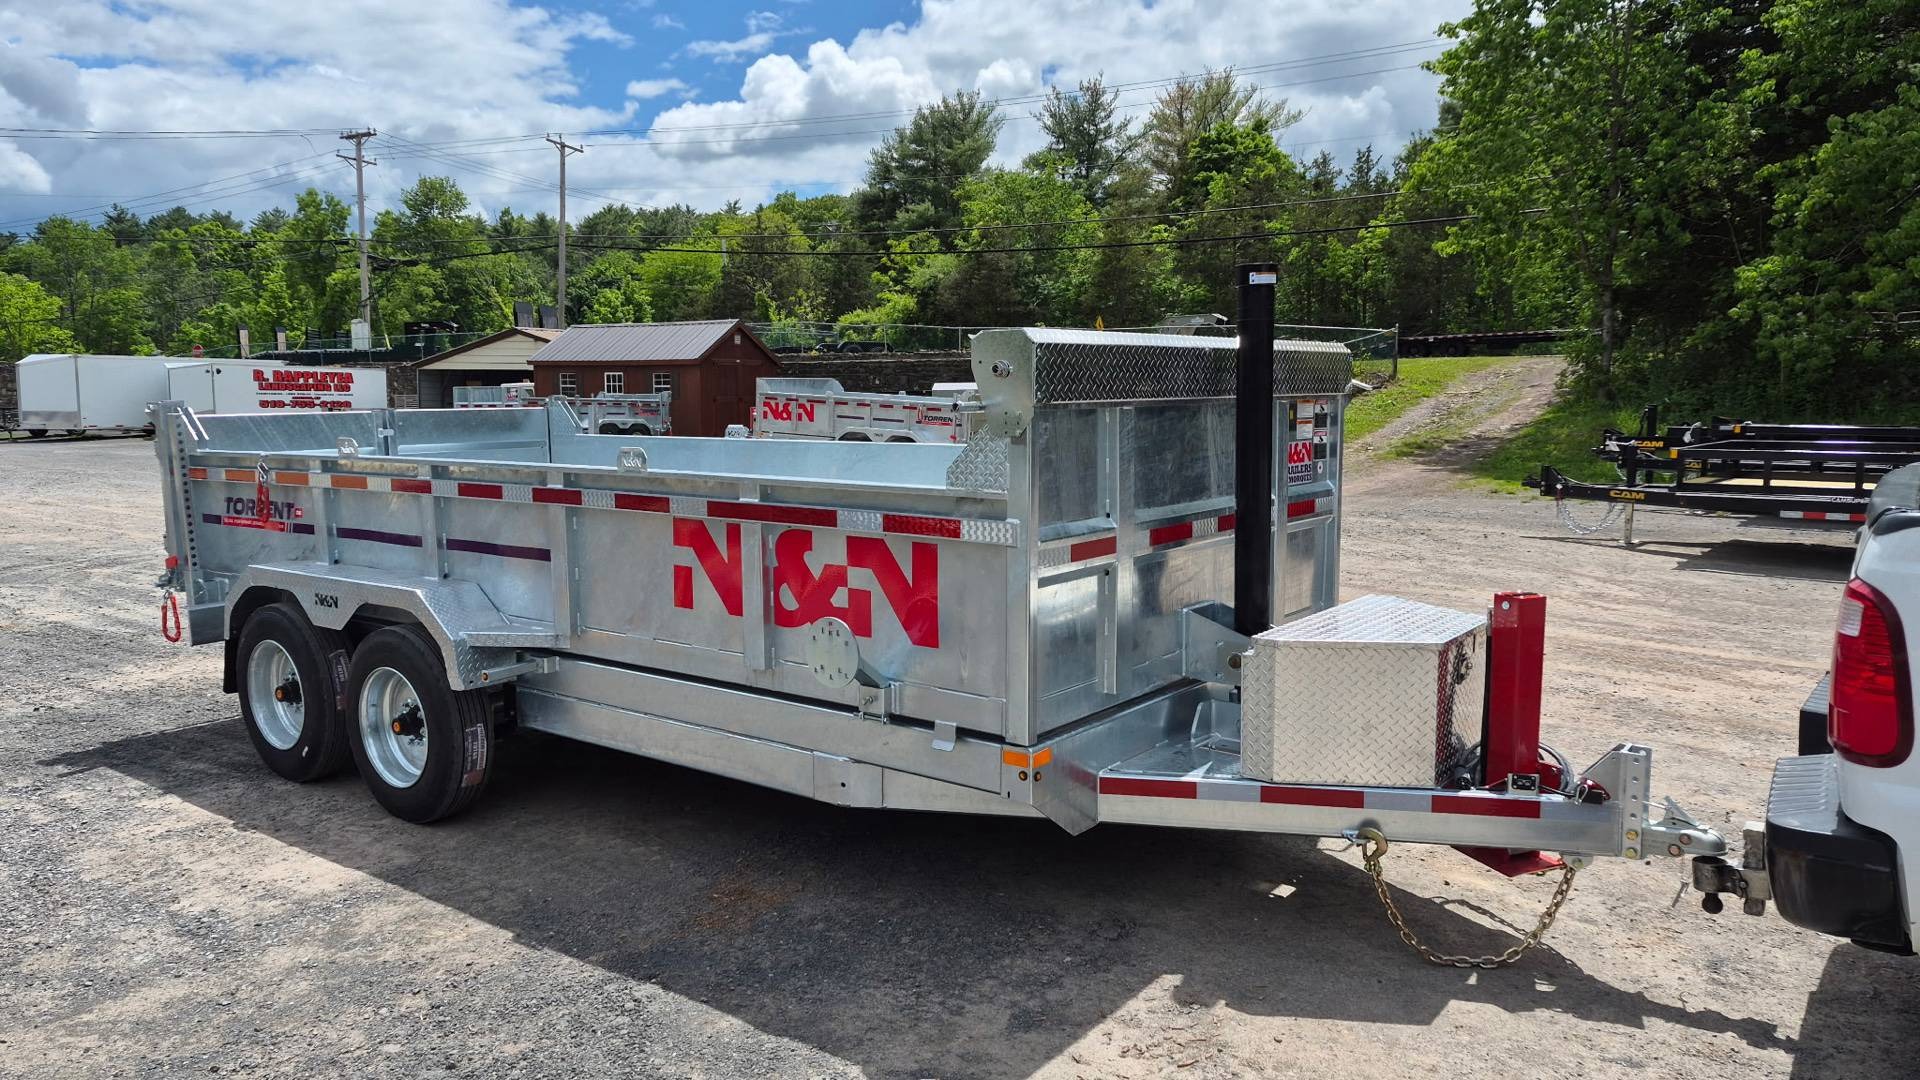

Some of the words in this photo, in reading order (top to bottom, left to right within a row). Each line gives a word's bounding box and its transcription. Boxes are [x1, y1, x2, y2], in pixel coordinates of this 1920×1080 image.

[253, 369, 269, 382] R.
[272, 370, 354, 384] RAPPLEYEA
[258, 382, 332, 392] LANDSCAPING
[334, 383, 351, 392] LLC
[763, 401, 815, 422] N&N
[923, 415, 957, 424] TORREN
[1288, 464, 1312, 475] RAILERS
[1609, 490, 1646, 500] CAM
[224, 496, 295, 520] TORENT
[673, 516, 939, 648] N&N
